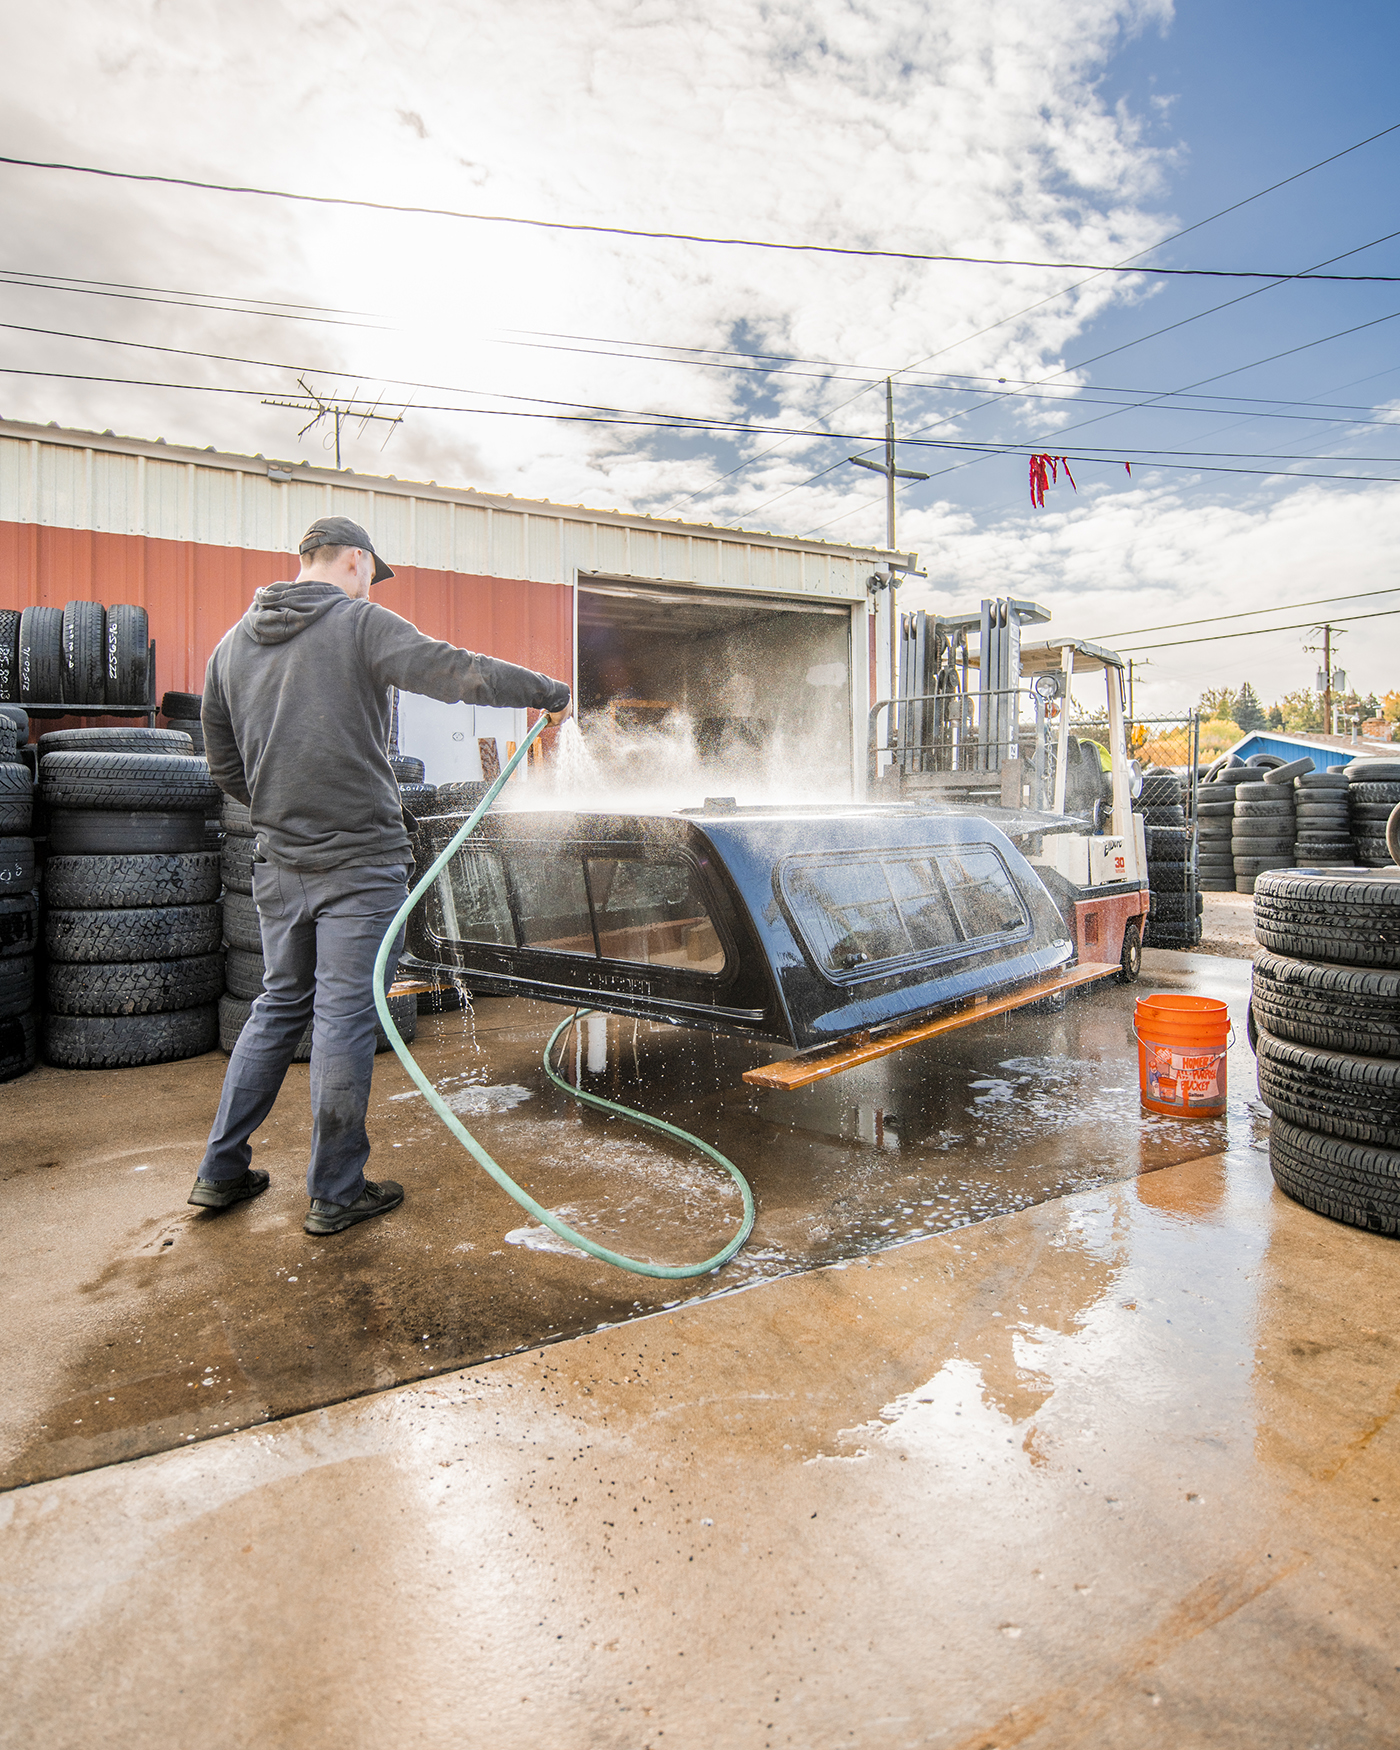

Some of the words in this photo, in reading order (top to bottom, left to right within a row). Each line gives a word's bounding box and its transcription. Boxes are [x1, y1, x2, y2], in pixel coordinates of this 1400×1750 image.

[23, 646, 31, 691] 215-60-16
[109, 623, 118, 680] 225-65-16
[1114, 856, 1125, 868] 30
